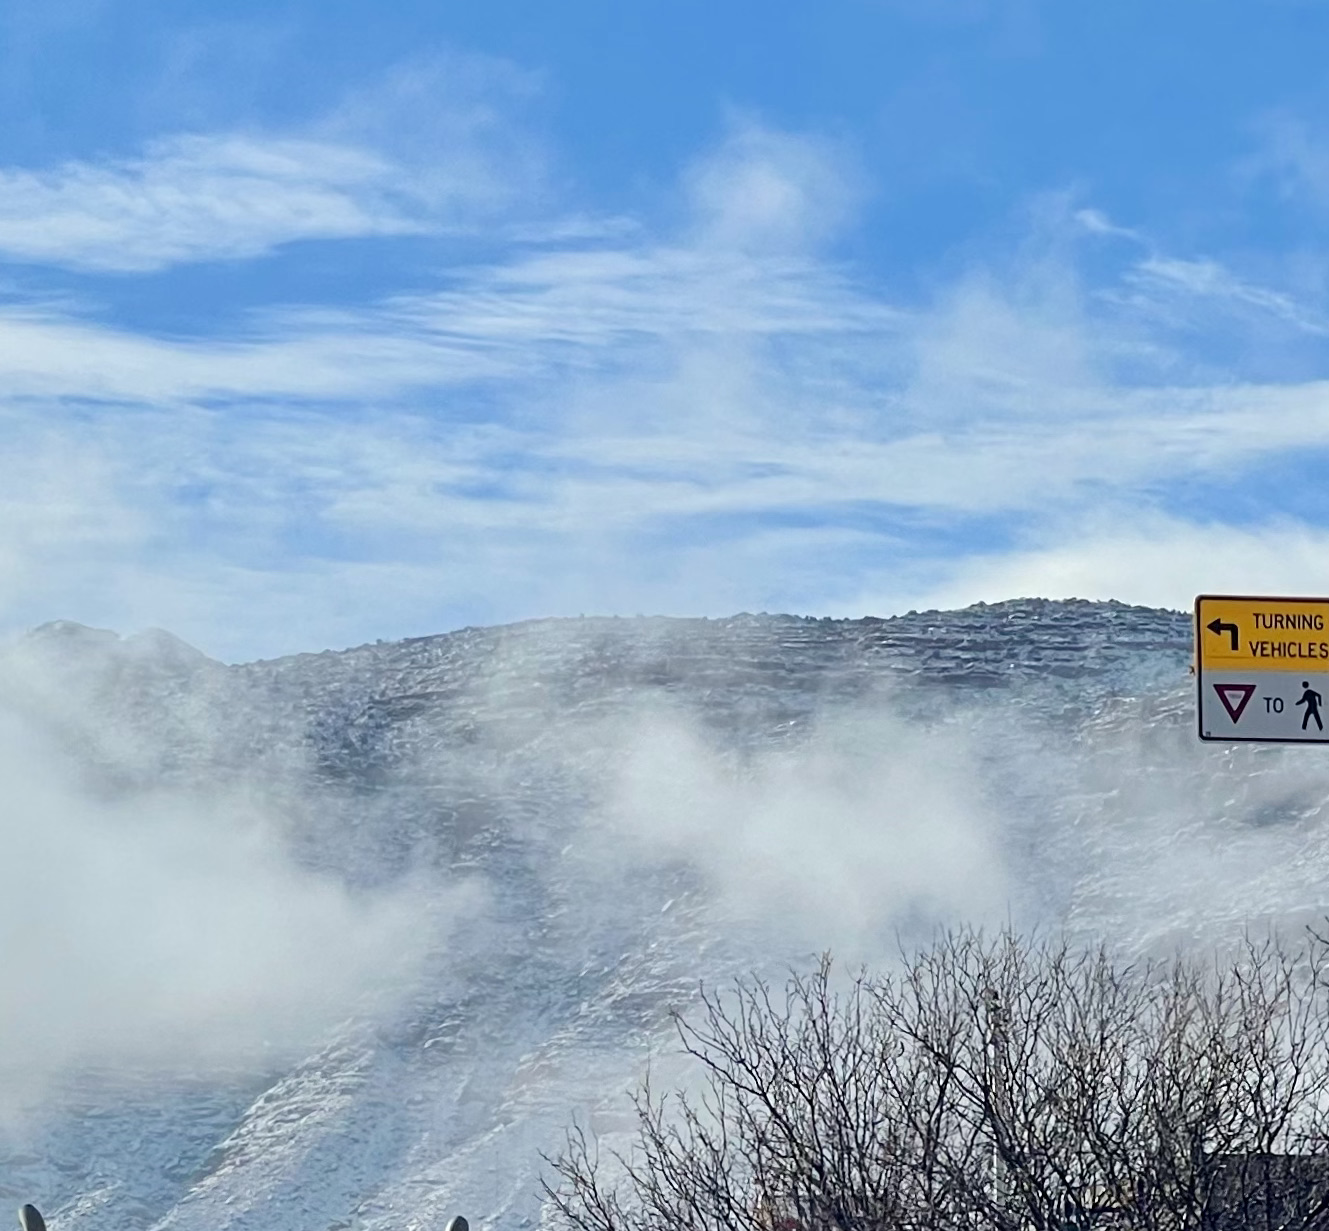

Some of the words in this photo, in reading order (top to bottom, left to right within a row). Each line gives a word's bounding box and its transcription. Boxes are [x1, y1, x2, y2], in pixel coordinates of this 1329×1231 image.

[1252, 612, 1324, 631] TURNING
[1248, 640, 1329, 659] VEHICLES
[1262, 696, 1285, 714] TO
